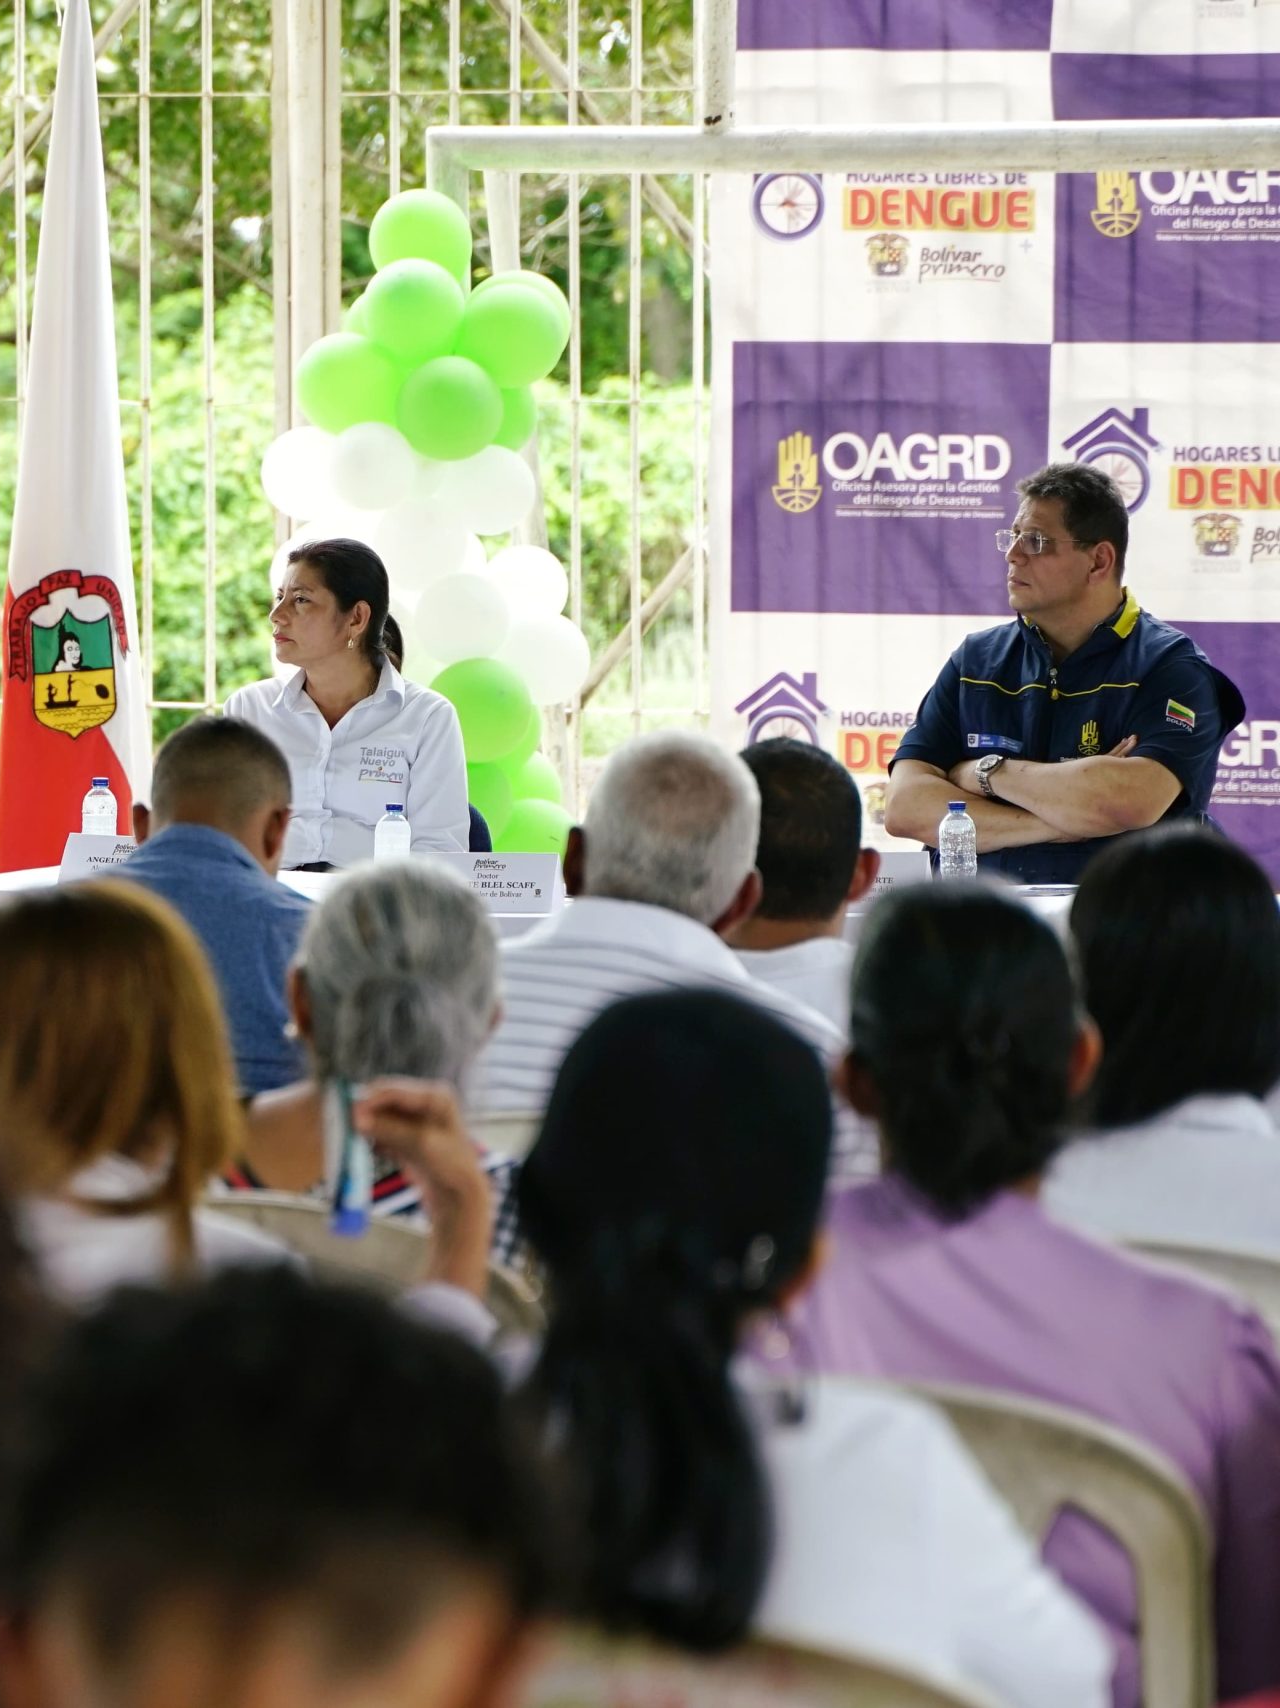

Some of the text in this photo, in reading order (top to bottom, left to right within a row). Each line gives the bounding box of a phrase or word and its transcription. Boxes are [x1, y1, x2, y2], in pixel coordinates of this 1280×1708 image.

[846, 173, 1027, 185] HOGARES LIBRES DE
[850, 189, 1029, 229] DENGUE
[1151, 205, 1276, 218] Oficina Asesora para la
[1172, 218, 1191, 229] del
[1192, 218, 1230, 231] Riesgo
[1231, 218, 1247, 229] de
[920, 245, 982, 263] Bolívar
[918, 263, 1007, 284] primero
[822, 432, 1012, 481] OAGRD
[1173, 446, 1262, 462] HOGARES
[832, 481, 1000, 497] Oficina Asesora para la Gestión
[1177, 468, 1280, 505] DEN
[853, 494, 983, 507] del Riesgo de Desastres
[47, 573, 72, 588] PAZ
[840, 711, 914, 727] HOGARE
[360, 758, 396, 767] Nuevo
[477, 872, 499, 880] Doctor
[481, 881, 505, 889] BLEL
[506, 881, 536, 889] SCAFF
[489, 890, 498, 898] de
[499, 890, 522, 898] Bolívar
